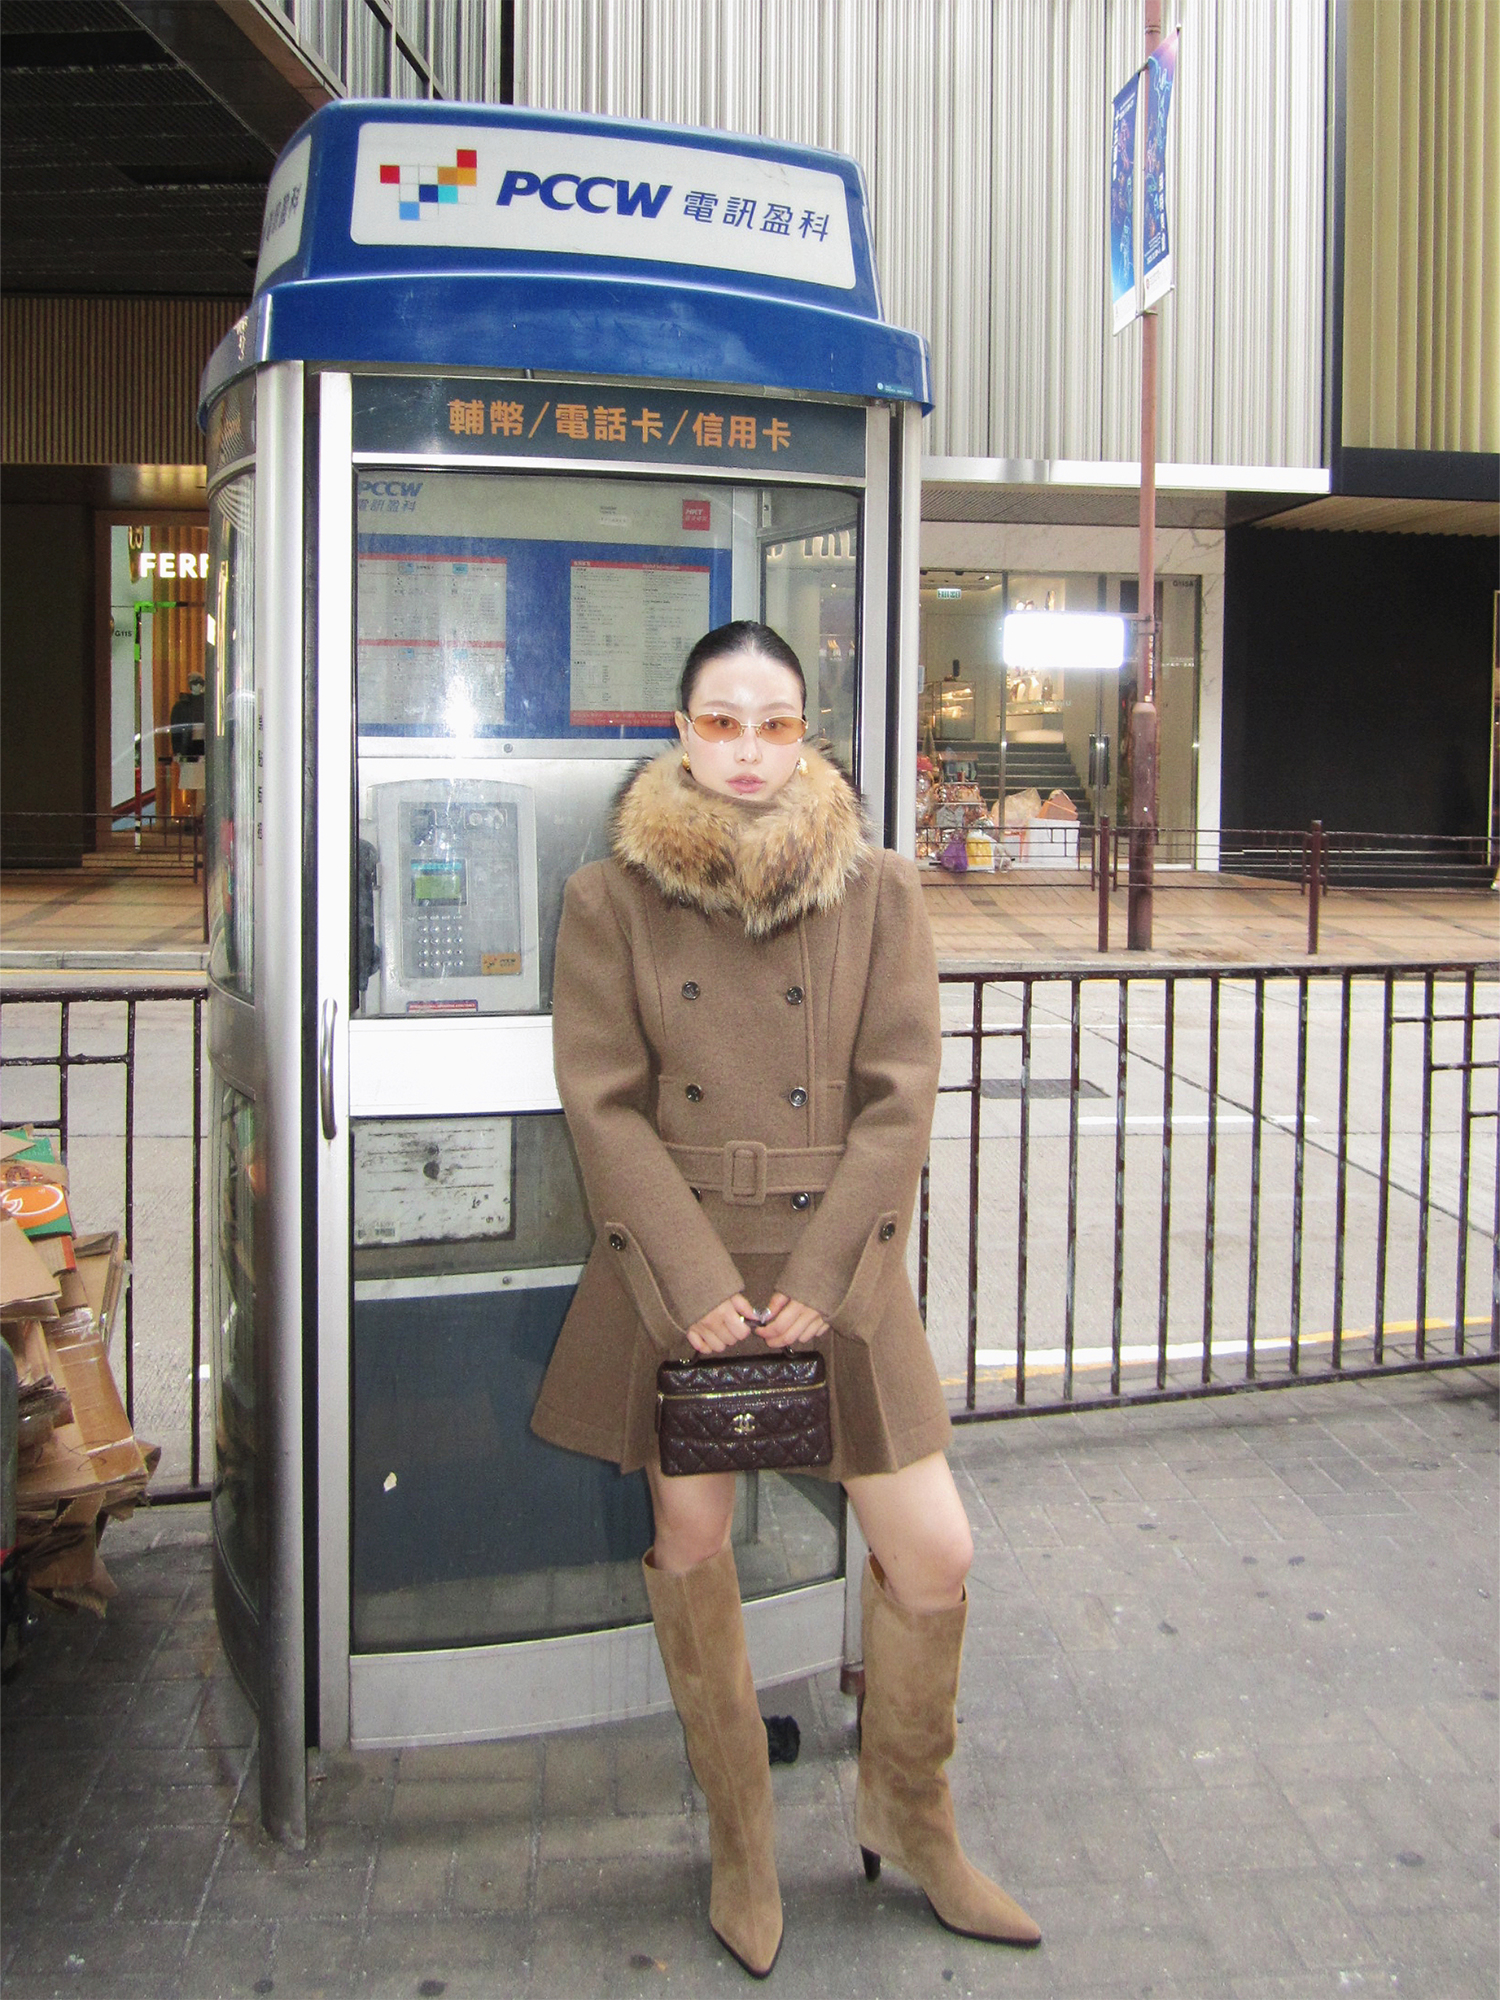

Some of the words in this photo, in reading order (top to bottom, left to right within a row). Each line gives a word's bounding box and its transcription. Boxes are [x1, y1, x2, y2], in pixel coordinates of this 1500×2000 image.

[496, 170, 673, 218] PCCW
[683, 190, 829, 242] 電訊盈科
[447, 399, 792, 452] 輔幣/電話卡/信用卡
[358, 481, 423, 497] PCCW
